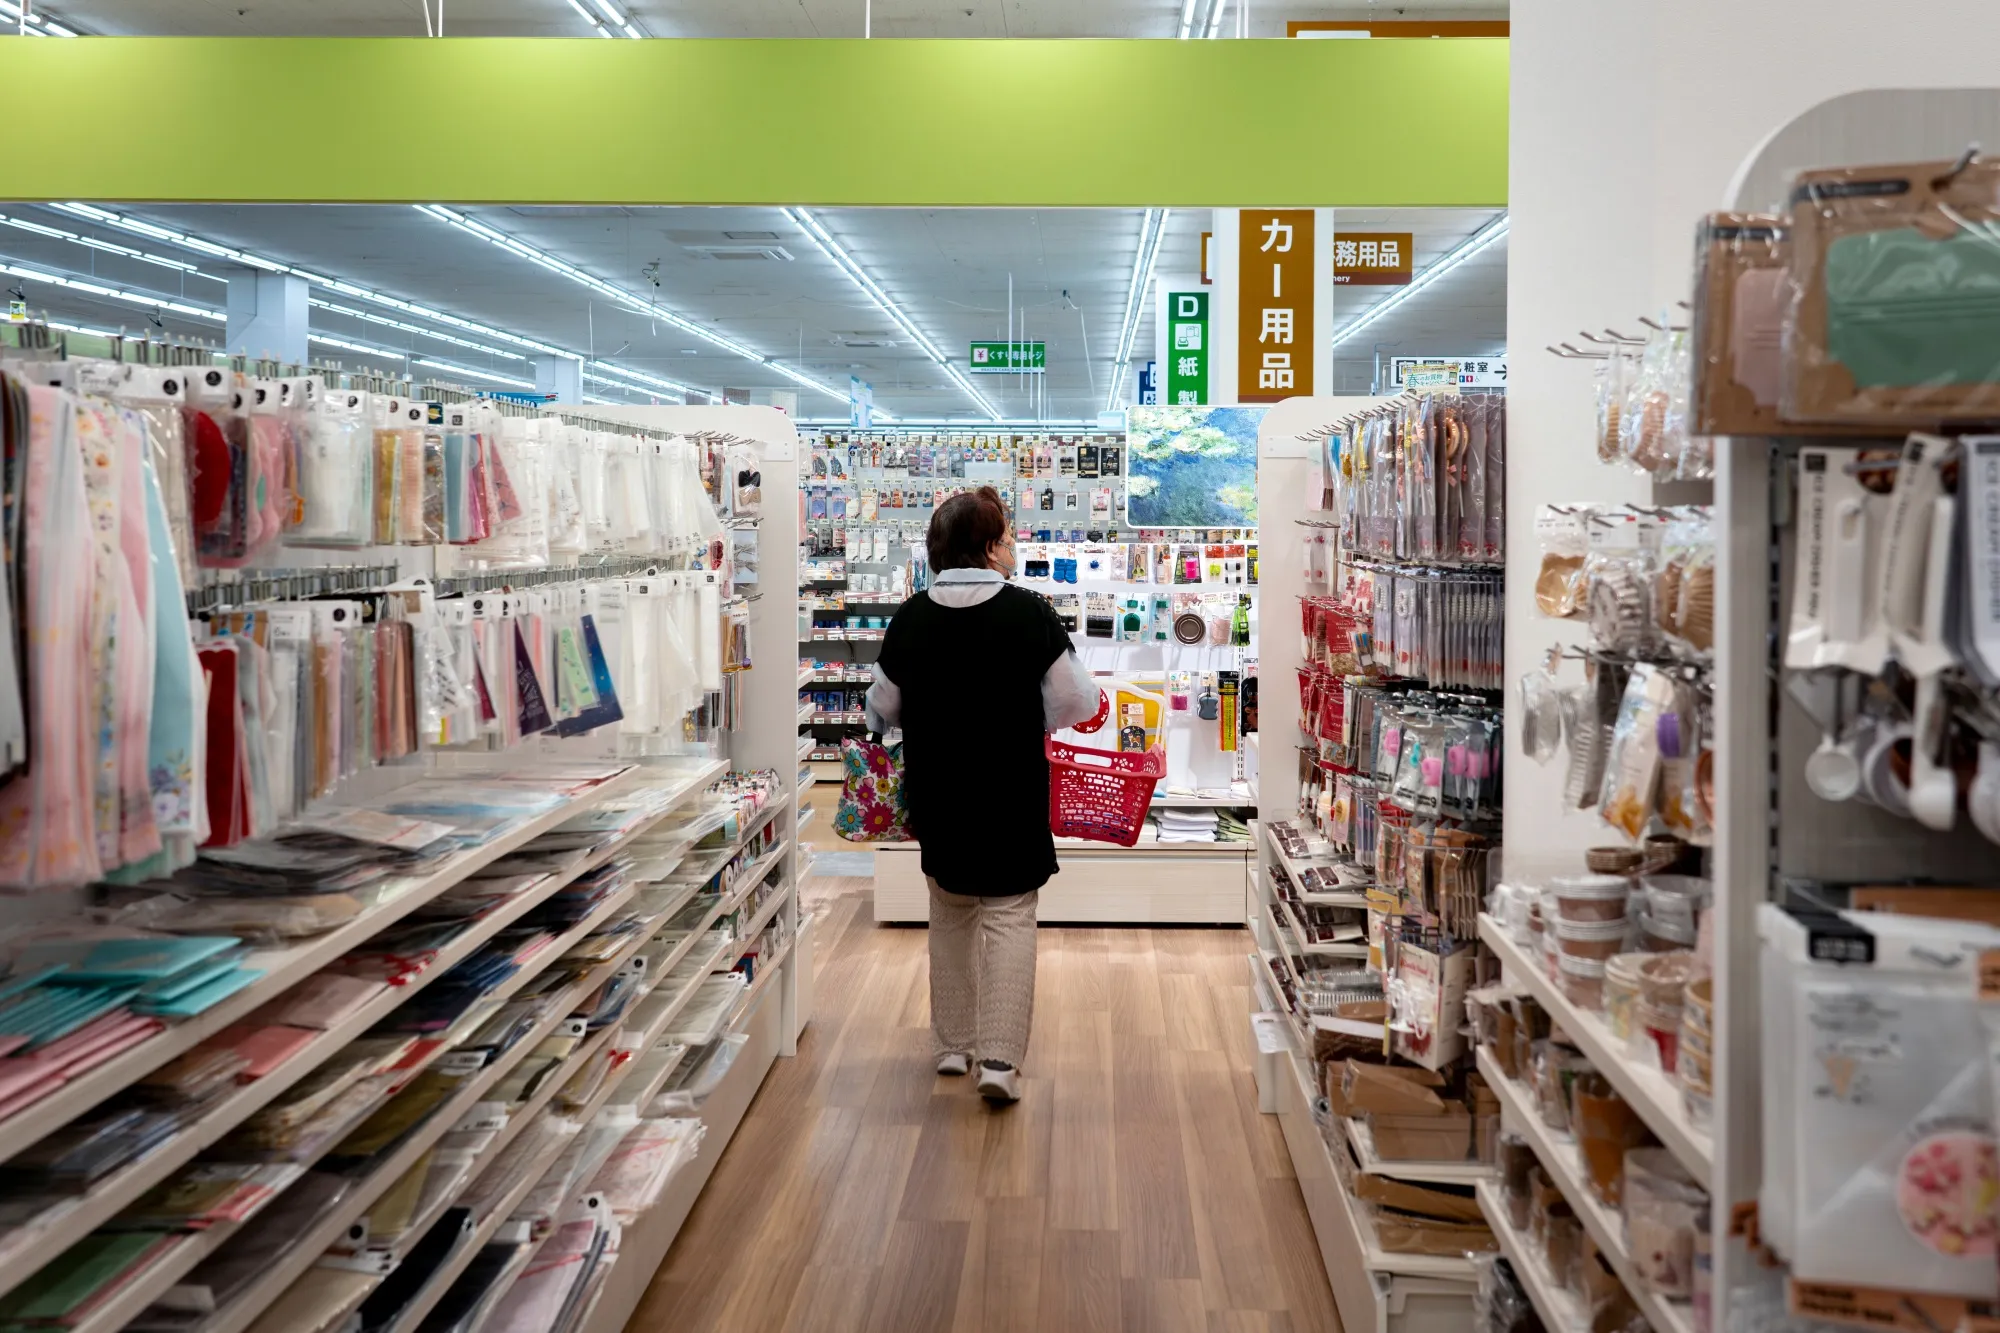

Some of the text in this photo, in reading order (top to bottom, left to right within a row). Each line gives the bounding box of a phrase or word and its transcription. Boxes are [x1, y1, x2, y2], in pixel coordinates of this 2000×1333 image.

[1333, 240, 1400, 268] 務用品
[1178, 296, 1199, 317] D
[1258, 218, 1294, 389] カー用品
